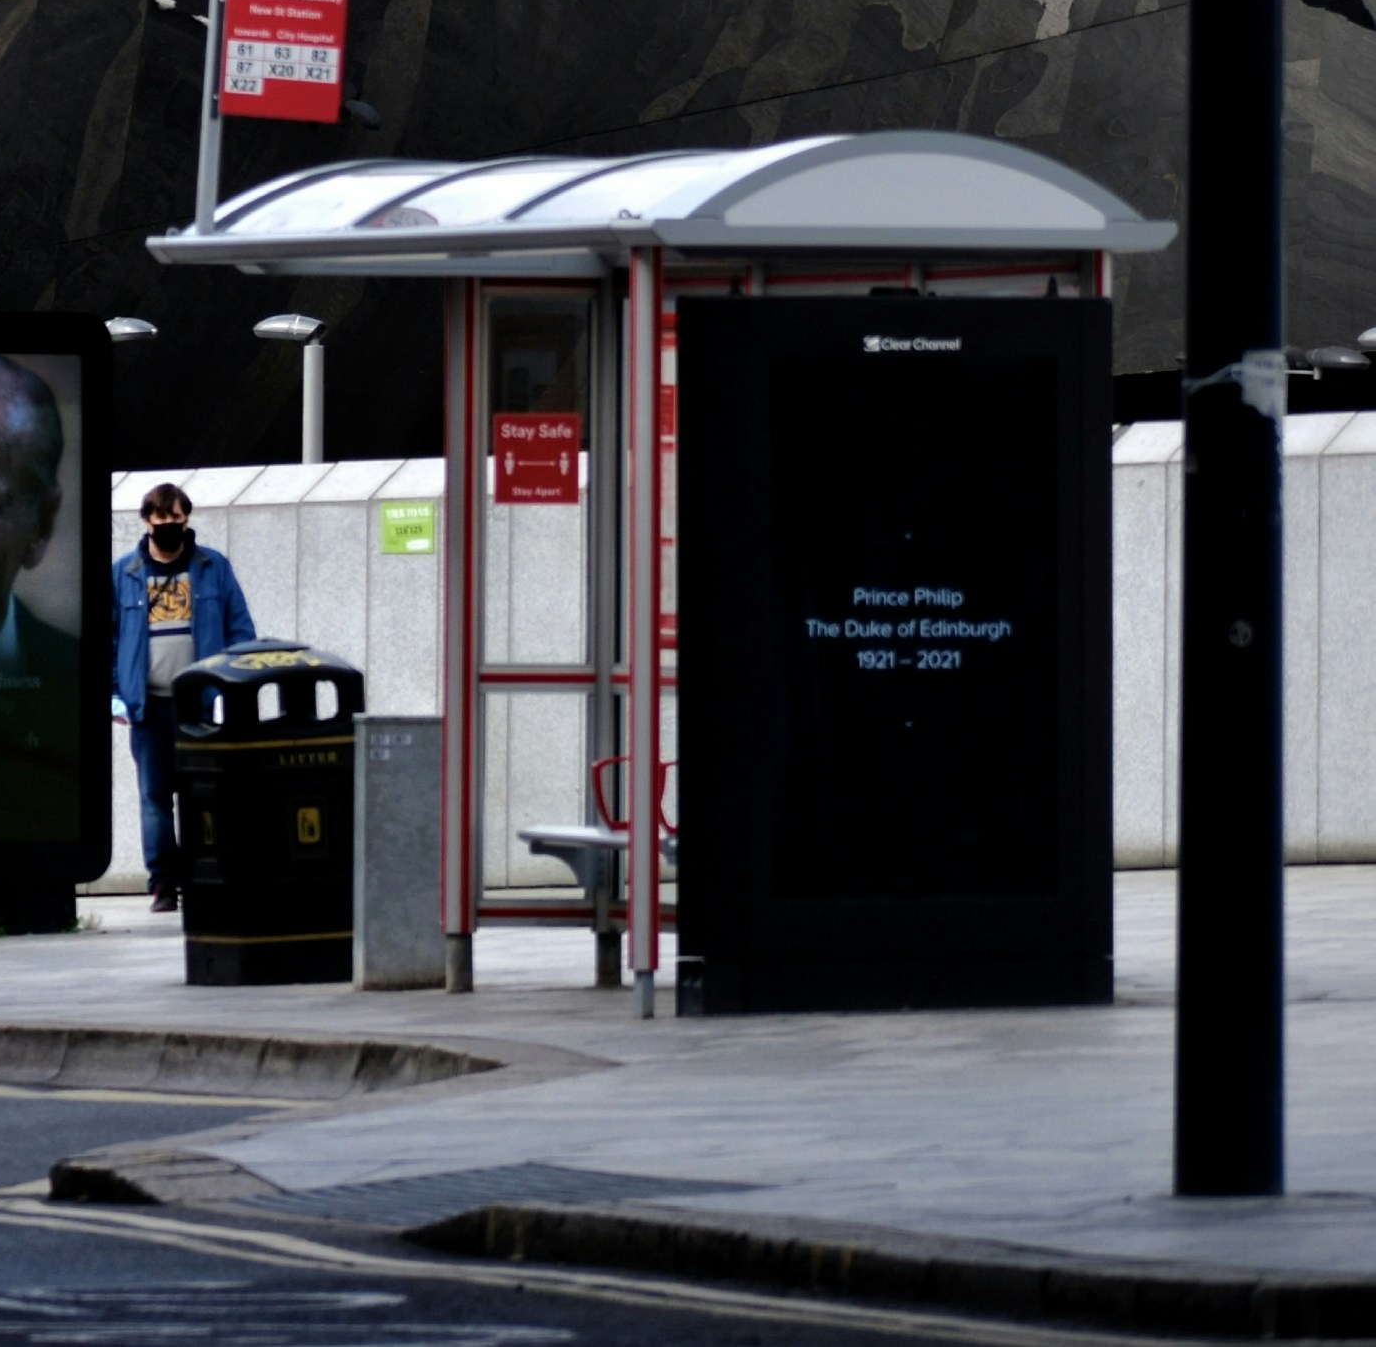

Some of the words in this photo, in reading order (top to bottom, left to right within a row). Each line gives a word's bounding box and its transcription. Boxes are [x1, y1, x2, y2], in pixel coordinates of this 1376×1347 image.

[250, 4, 271, 15] New
[287, 8, 322, 20] Station
[297, 32, 335, 44] Hospital
[269, 64, 294, 77] X20
[305, 67, 330, 80] X21
[881, 337, 911, 351] Clear
[913, 337, 961, 351] Channel
[501, 424, 534, 440] Stay
[539, 424, 572, 438] Safe
[512, 486, 532, 497] Stay
[535, 487, 561, 498] Apart
[853, 588, 909, 606] Prince
[914, 587, 964, 609] Philip
[806, 619, 839, 638] The
[844, 619, 892, 638] Duke
[897, 619, 916, 638] of
[920, 619, 1011, 641] Edinburgh
[857, 651, 895, 669] 1921
[917, 651, 961, 669] 2021
